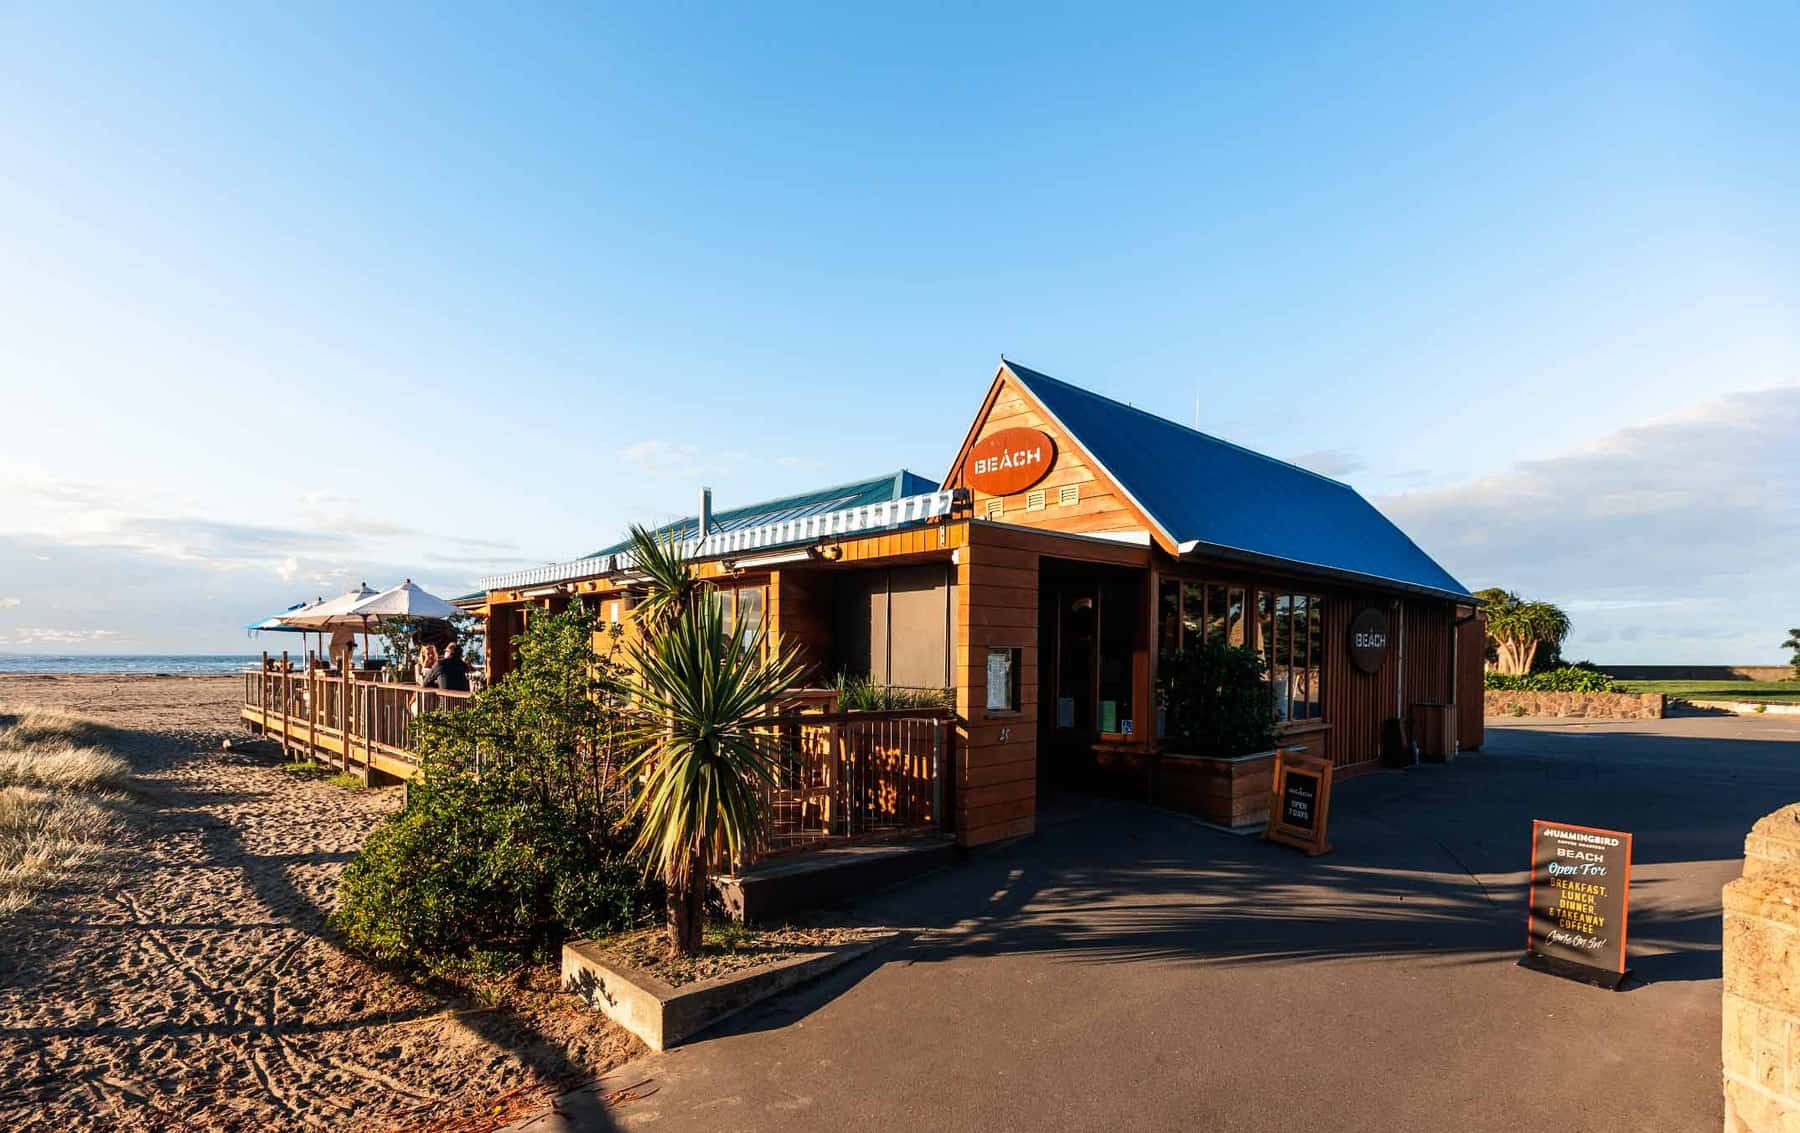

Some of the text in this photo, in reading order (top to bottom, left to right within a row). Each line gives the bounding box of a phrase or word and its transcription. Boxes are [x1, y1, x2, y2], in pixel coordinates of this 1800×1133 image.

[975, 447, 1041, 475] BEACH
[1355, 632, 1386, 648] BEACH
[1544, 829, 1619, 846] HUMMINGBIRD
[1557, 848, 1604, 863] BEACH
[1548, 861, 1607, 876] Open For
[1556, 908, 1604, 927] TAKEAWAY
[1559, 919, 1594, 934] COFFEE
